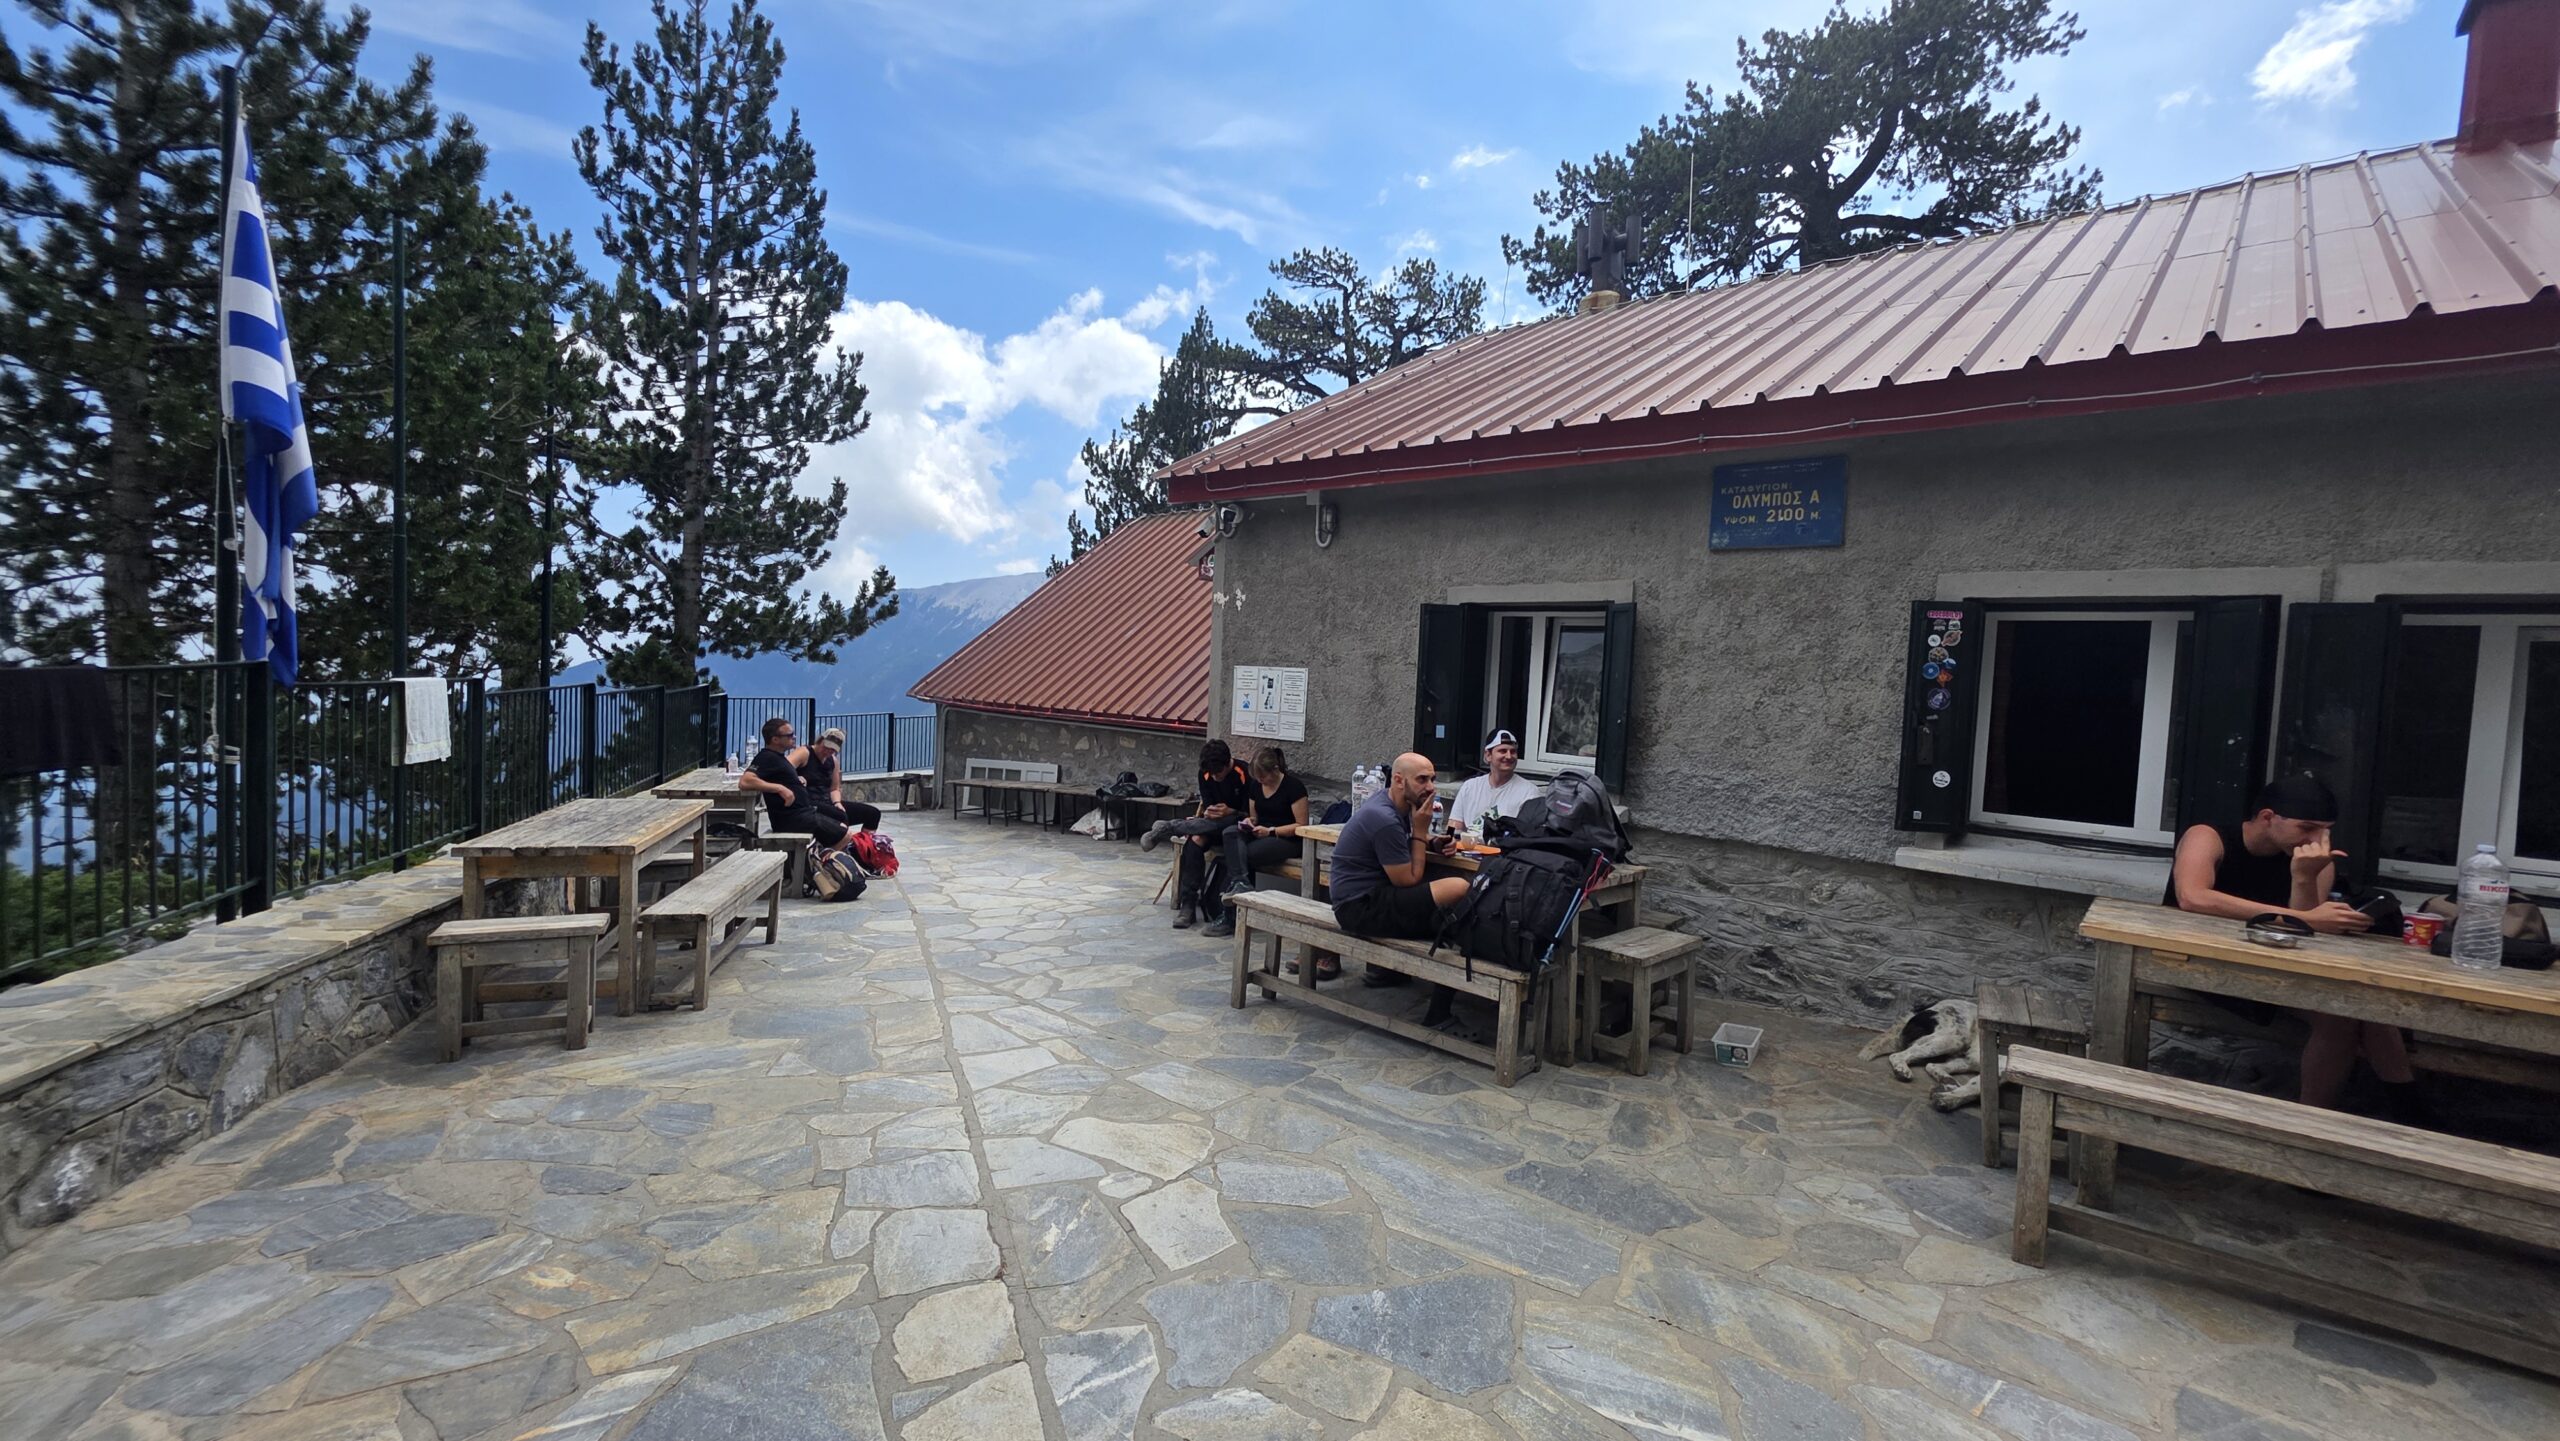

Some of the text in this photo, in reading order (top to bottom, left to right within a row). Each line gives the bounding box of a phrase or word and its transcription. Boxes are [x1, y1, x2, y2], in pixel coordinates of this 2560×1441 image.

[1732, 489, 1819, 509] ΟΛΥΜΠΟΣ Α
[1766, 507, 1804, 522] 2100
